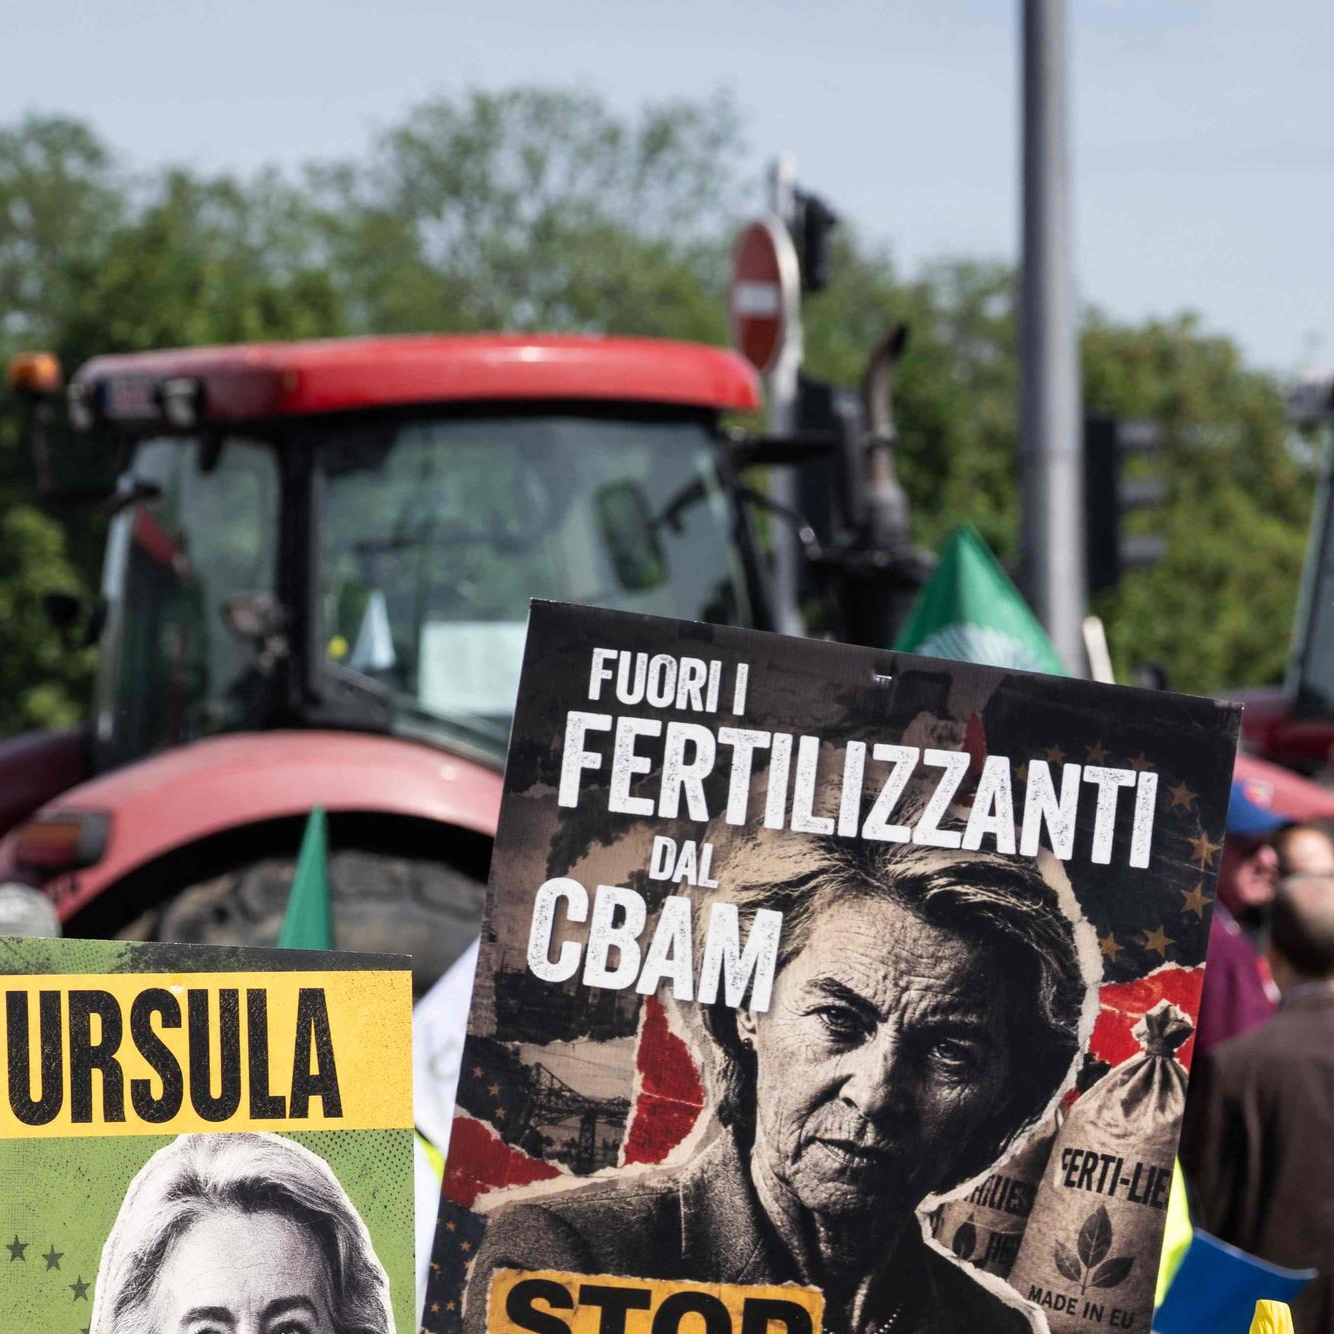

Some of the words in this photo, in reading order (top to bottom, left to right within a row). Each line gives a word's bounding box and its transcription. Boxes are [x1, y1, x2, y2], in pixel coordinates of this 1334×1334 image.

[587, 647, 721, 715] FUORI
[732, 662, 750, 716] I
[557, 709, 1159, 870] FERTILIZZANTI
[649, 834, 718, 889] DAL
[526, 876, 782, 1013] CBAM
[6, 986, 344, 1128] URSULA
[1028, 1284, 1078, 1316] MADE
[1082, 1301, 1104, 1323] IN
[1109, 1308, 1135, 1329] EU
